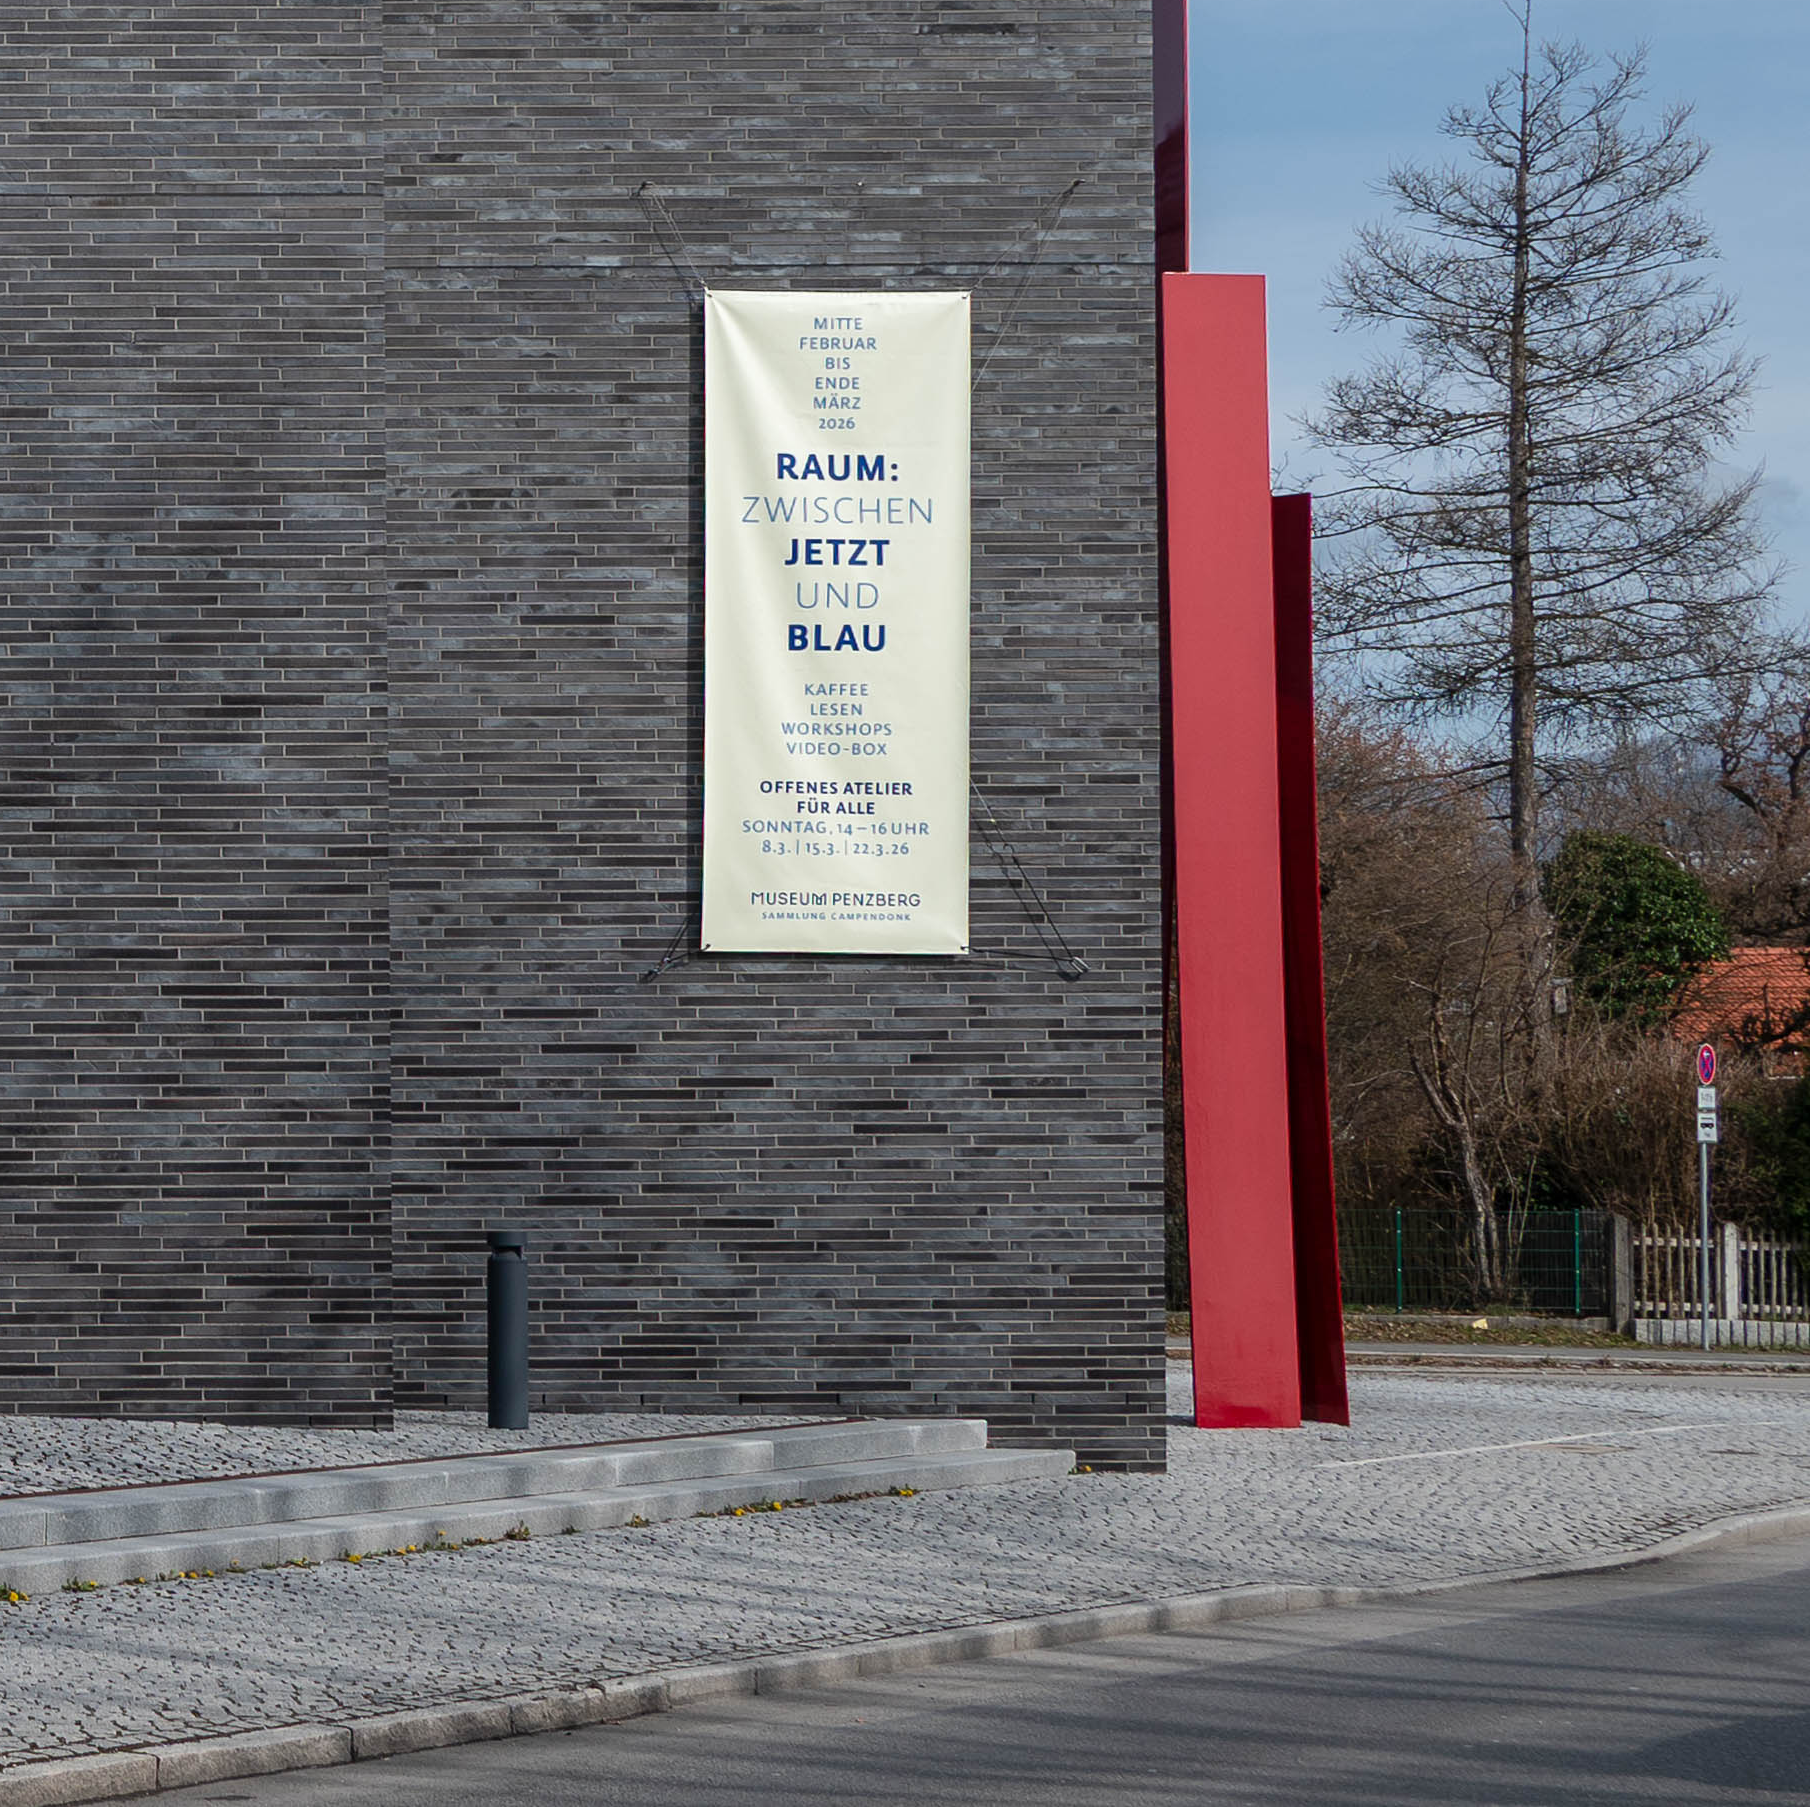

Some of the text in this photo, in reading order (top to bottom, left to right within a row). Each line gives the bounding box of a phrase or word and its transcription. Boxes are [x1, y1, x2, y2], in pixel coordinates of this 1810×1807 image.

[813, 316, 863, 331] MITTE
[799, 336, 878, 351] FEBRUAR
[825, 356, 851, 371] BIS
[814, 376, 860, 390] ENDE
[813, 392, 862, 410] MÄRZ
[818, 416, 856, 430] 2026
[776, 452, 899, 482] RAUM:
[741, 496, 932, 525] ZWISCHEN
[784, 538, 891, 567] JETZT
[796, 581, 879, 610] UND
[787, 623, 886, 652] BLAU
[804, 682, 869, 697] KAFFEE
[810, 702, 863, 717] LESEN
[781, 722, 893, 737] WORKSHOPS
[786, 741, 888, 756] VIDEO-BOX
[759, 780, 913, 796] OFFENES ATELIER
[796, 796, 876, 815] FÜR ALLE
[836, 823, 853, 836] 14
[870, 821, 888, 836] 16
[890, 821, 930, 836] UHR
[751, 891, 921, 908] MUSEUM PENZBERG
[761, 911, 911, 921] SAMMLUNG CAMPENDONK
